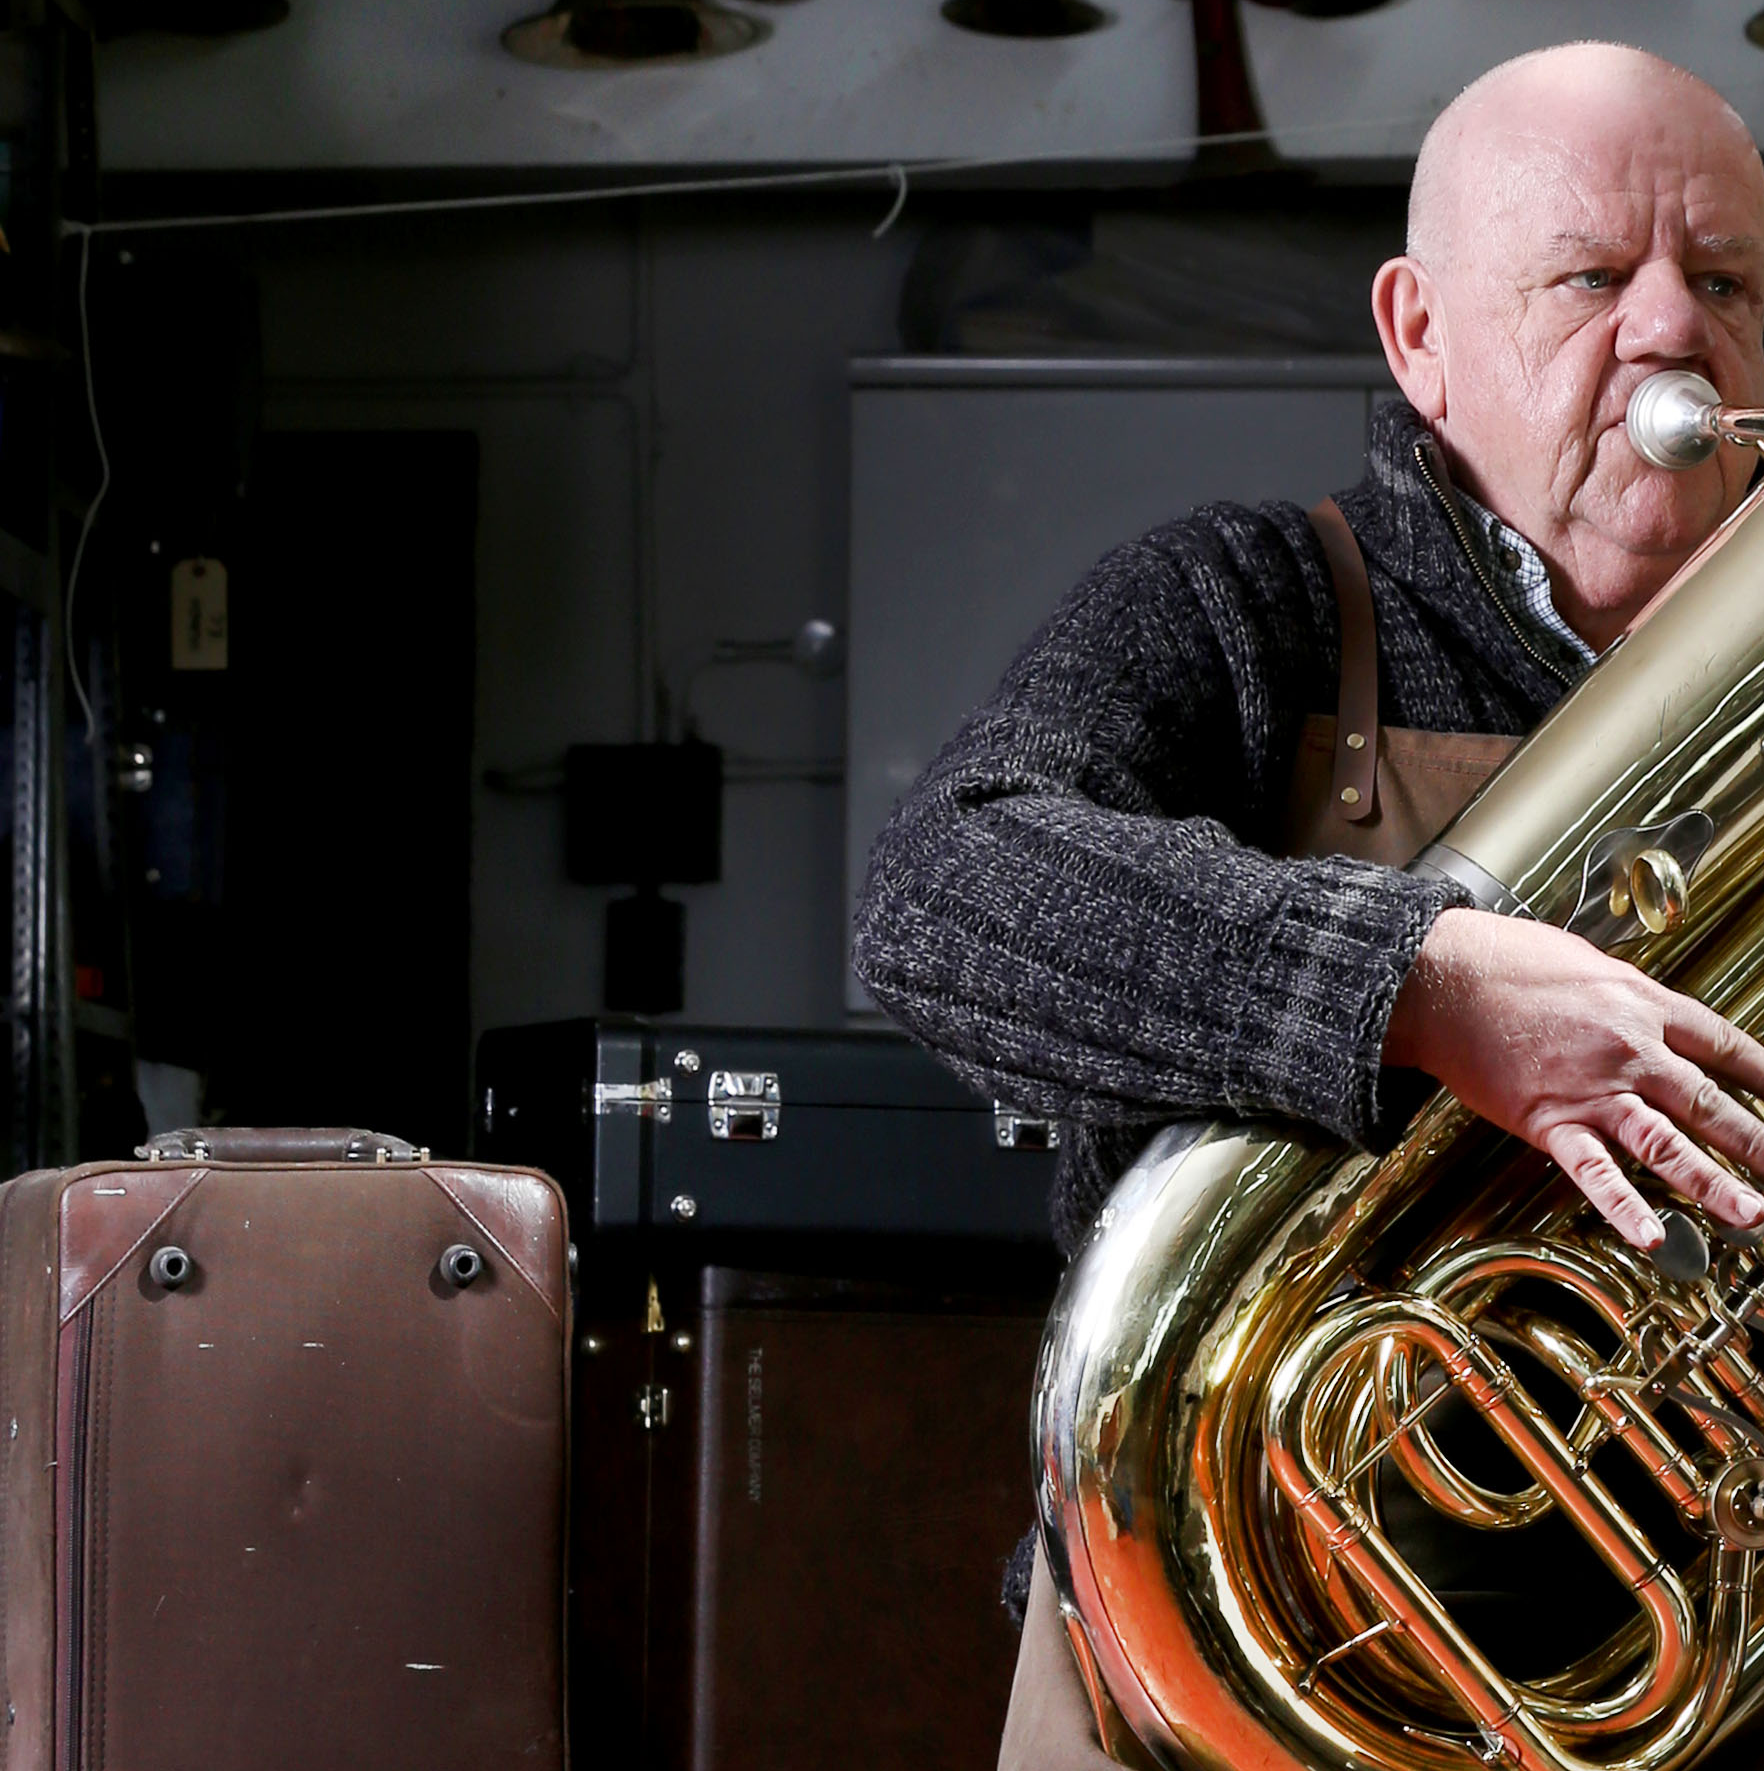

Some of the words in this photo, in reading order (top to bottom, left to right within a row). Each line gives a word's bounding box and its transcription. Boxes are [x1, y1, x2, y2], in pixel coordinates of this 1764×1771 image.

[748, 1346, 763, 1375] THE
[748, 1377, 763, 1437] SELMER
[748, 1438, 763, 1505] COMPANY
